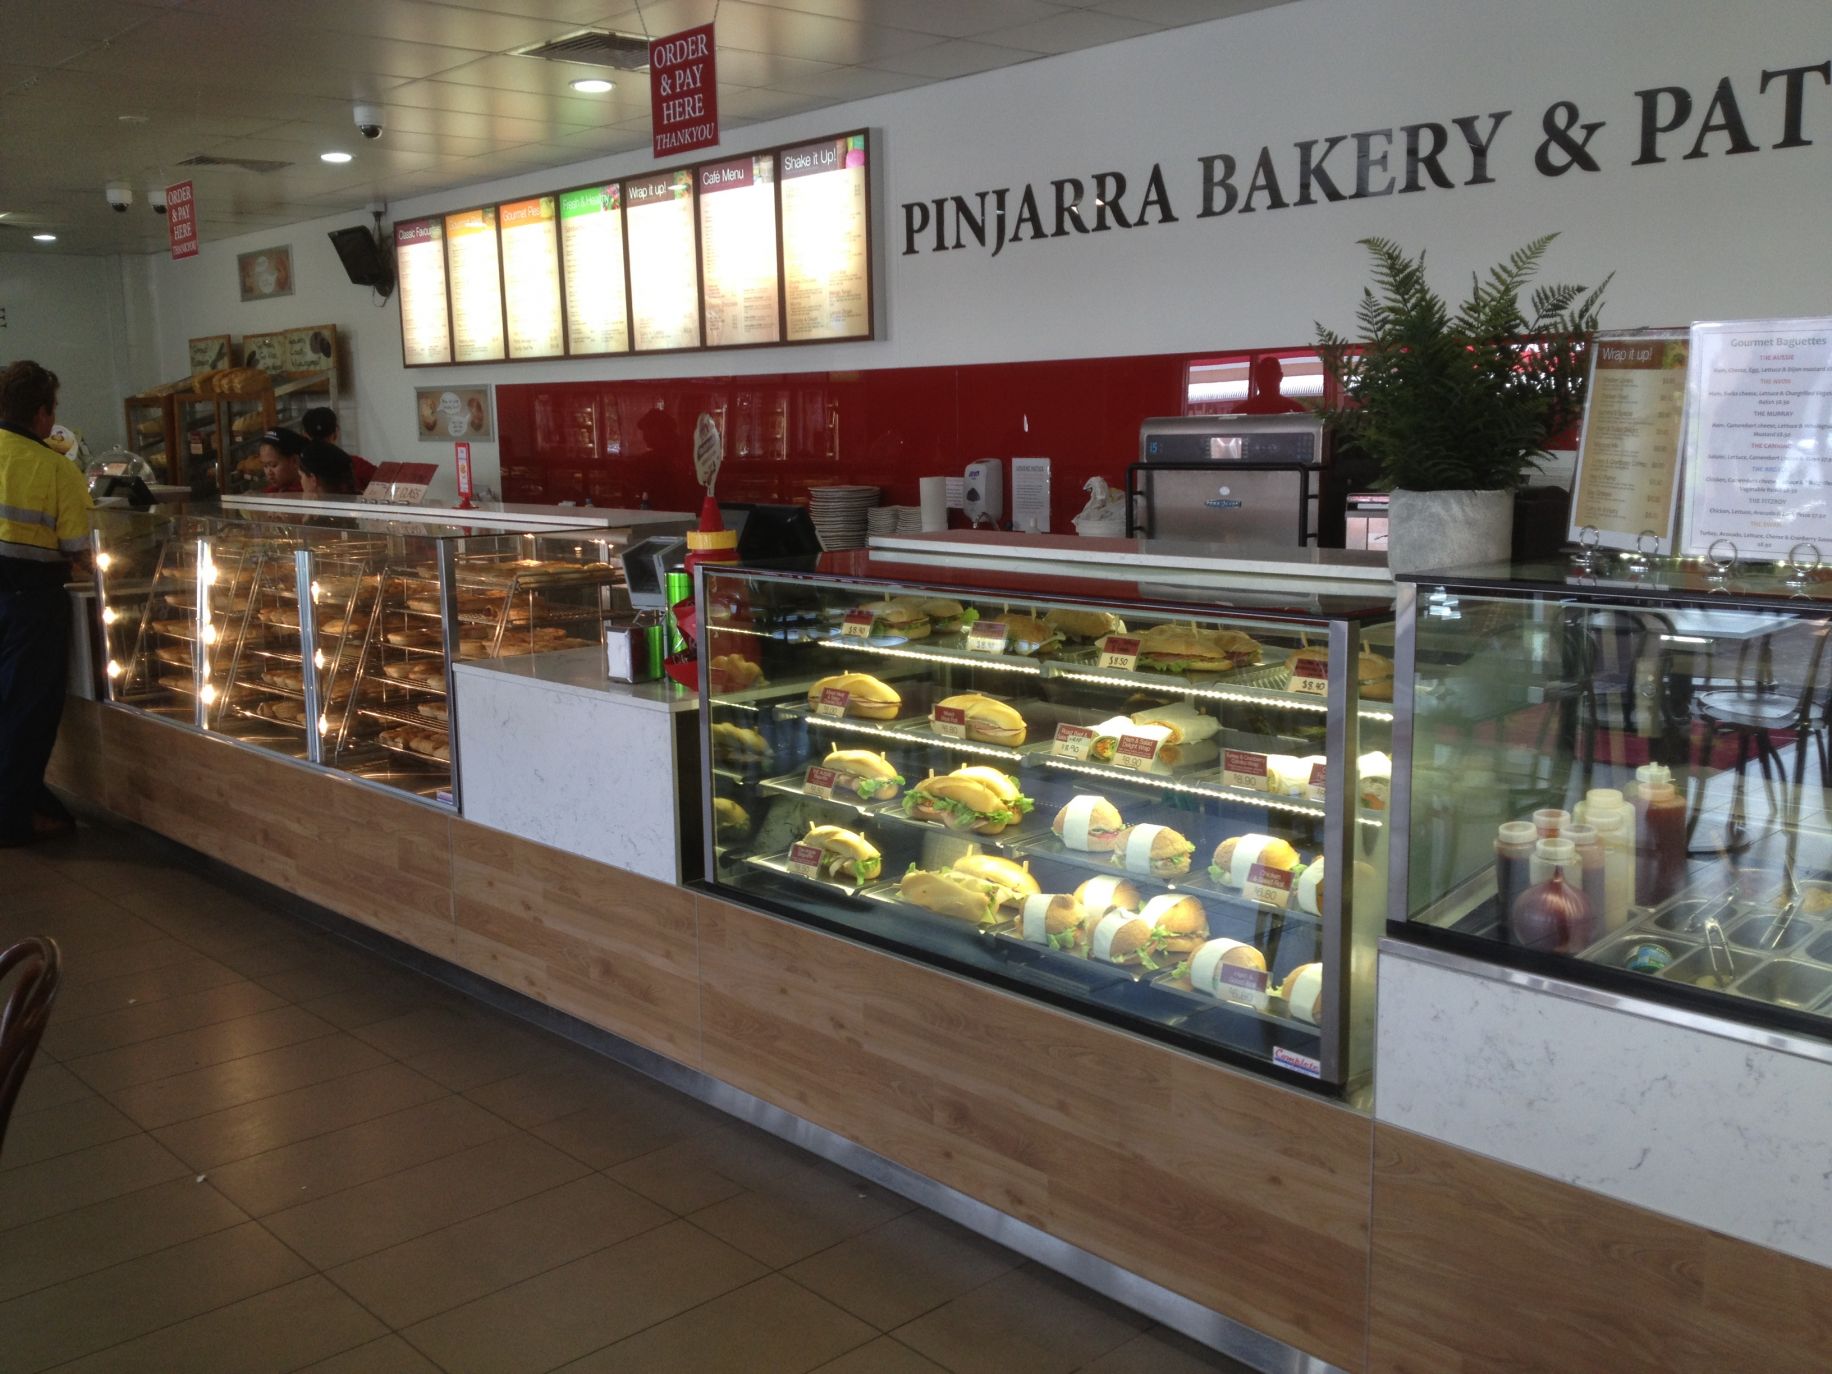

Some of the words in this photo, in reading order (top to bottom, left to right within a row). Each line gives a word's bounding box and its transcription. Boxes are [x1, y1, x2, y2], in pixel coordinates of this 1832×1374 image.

[654, 34, 708, 69] ORDER
[660, 74, 672, 96] &
[675, 64, 704, 93] PAY
[662, 94, 705, 125] HERE
[656, 123, 715, 150] THANKYOU
[784, 155, 811, 171] Shake
[813, 153, 819, 166] it
[820, 148, 838, 165] Up!
[901, 162, 1179, 257] PINJARRA
[1196, 109, 1512, 219] BAKERY
[1534, 100, 1606, 178] &
[1631, 59, 1832, 166] PAT
[702, 171, 720, 186] Café
[722, 167, 744, 183] Menu
[168, 186, 192, 205] ORDER
[629, 186, 648, 199] Wrap
[648, 183, 653, 195] it
[654, 179, 667, 197] up!
[178, 204, 191, 220] PAY
[503, 209, 527, 223] Gourmet
[173, 222, 192, 240] HERE
[1730, 338, 1773, 348] Gourmet
[1776, 336, 1827, 349] Baguettes
[1602, 347, 1626, 362] Wrap
[1628, 347, 1635, 361] it
[1636, 347, 1654, 363] up!
